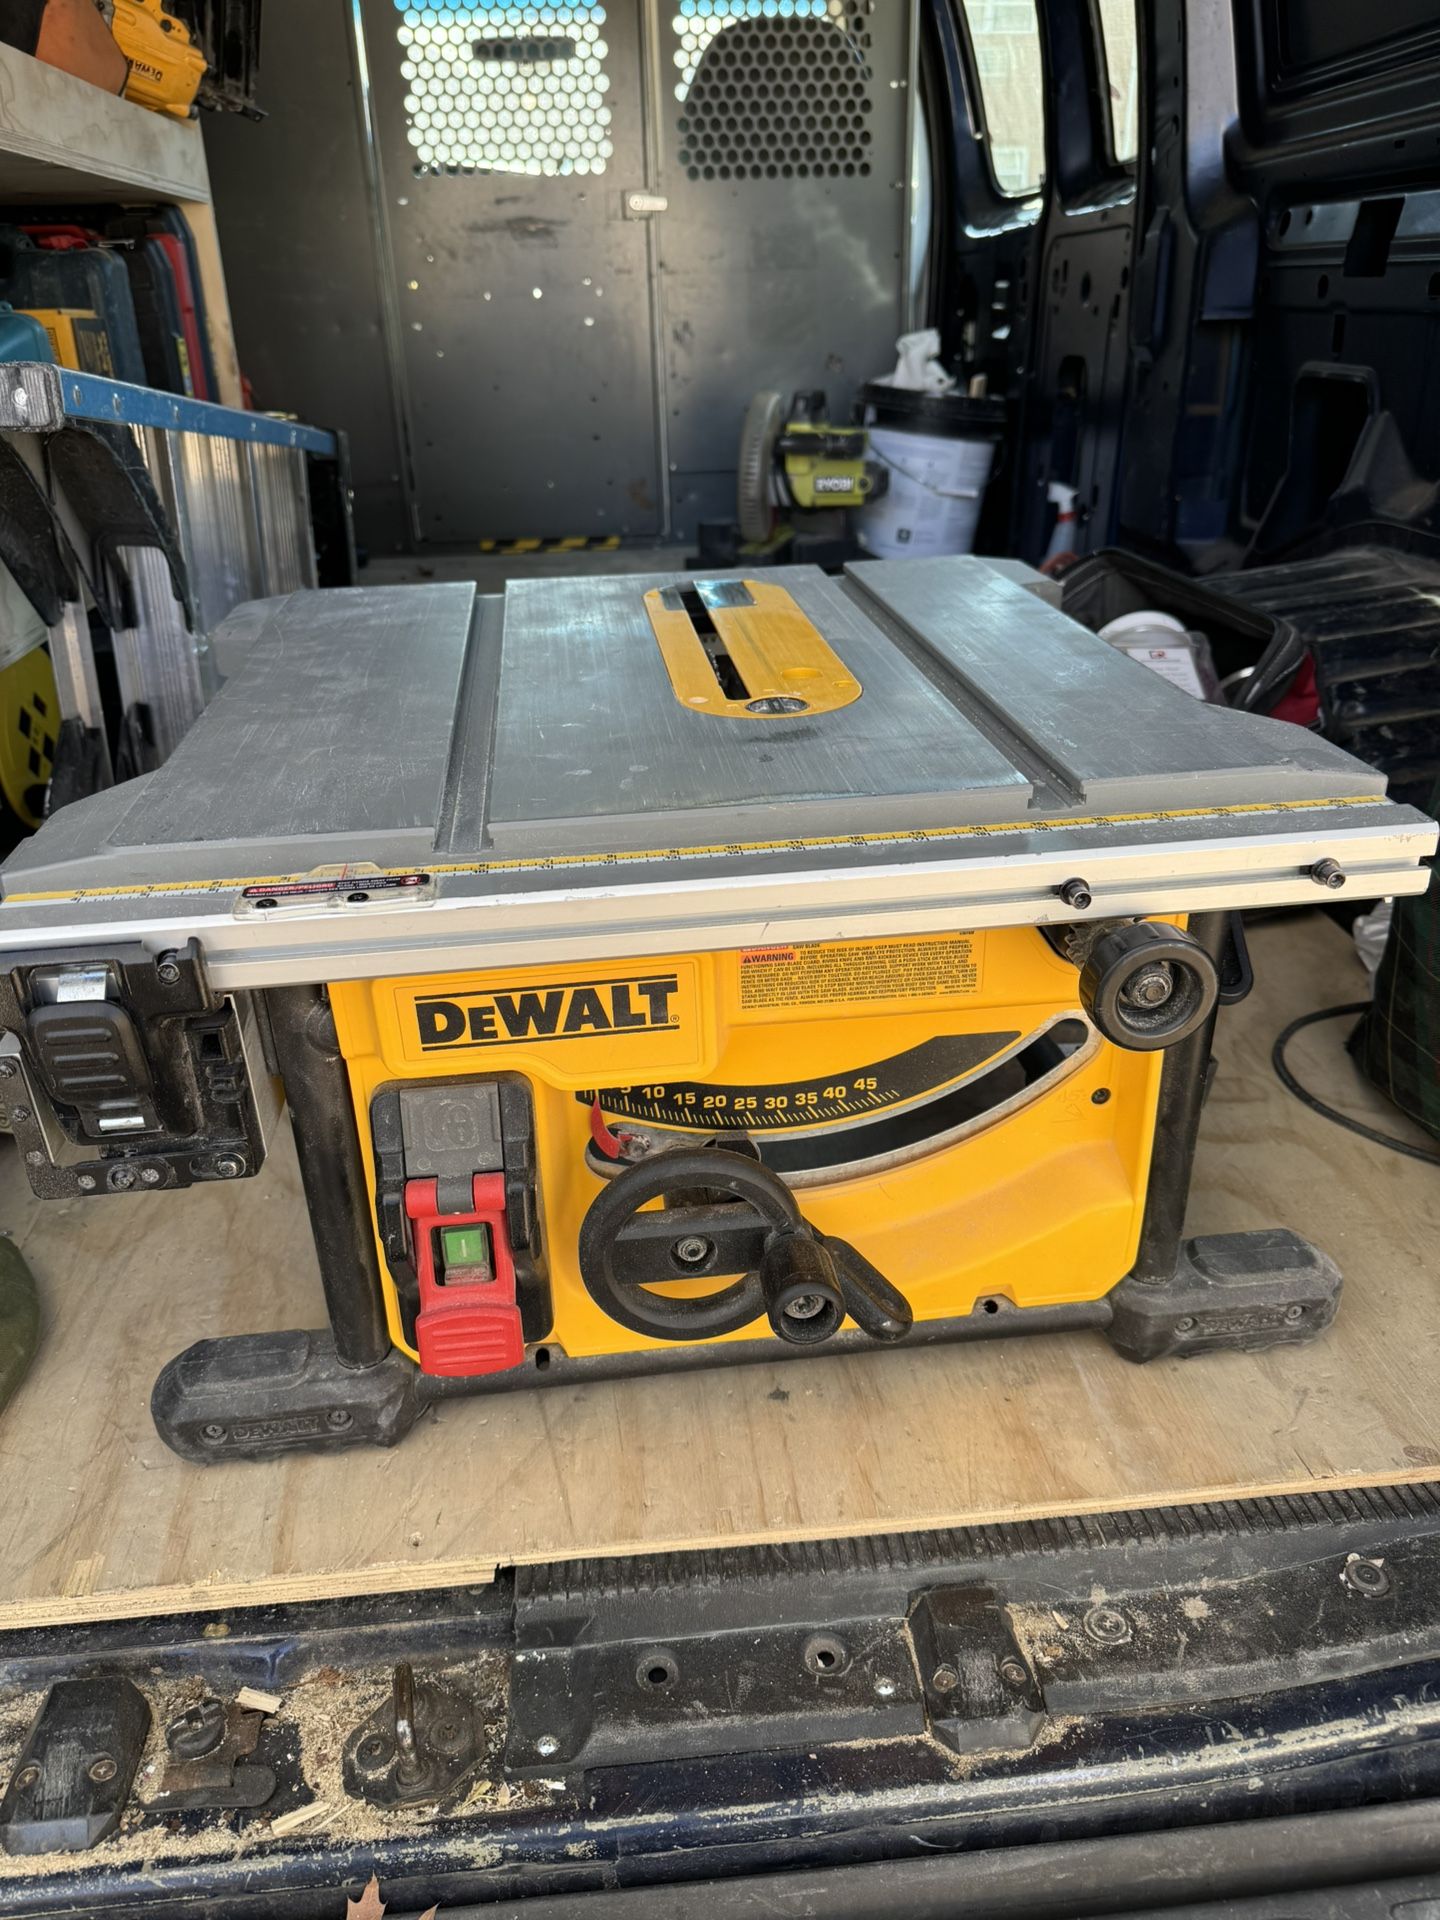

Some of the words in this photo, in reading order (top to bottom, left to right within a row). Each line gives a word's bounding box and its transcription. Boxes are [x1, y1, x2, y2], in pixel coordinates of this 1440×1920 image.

[752, 952, 794, 962] WARNING
[641, 1086, 665, 1099] 10
[673, 1092, 696, 1105] 15
[703, 1095, 727, 1108] 20
[734, 1097, 757, 1110] 25
[764, 1096, 788, 1109] 30
[795, 1092, 818, 1105] 35
[823, 1086, 846, 1099] 40
[854, 1077, 877, 1090] 45
